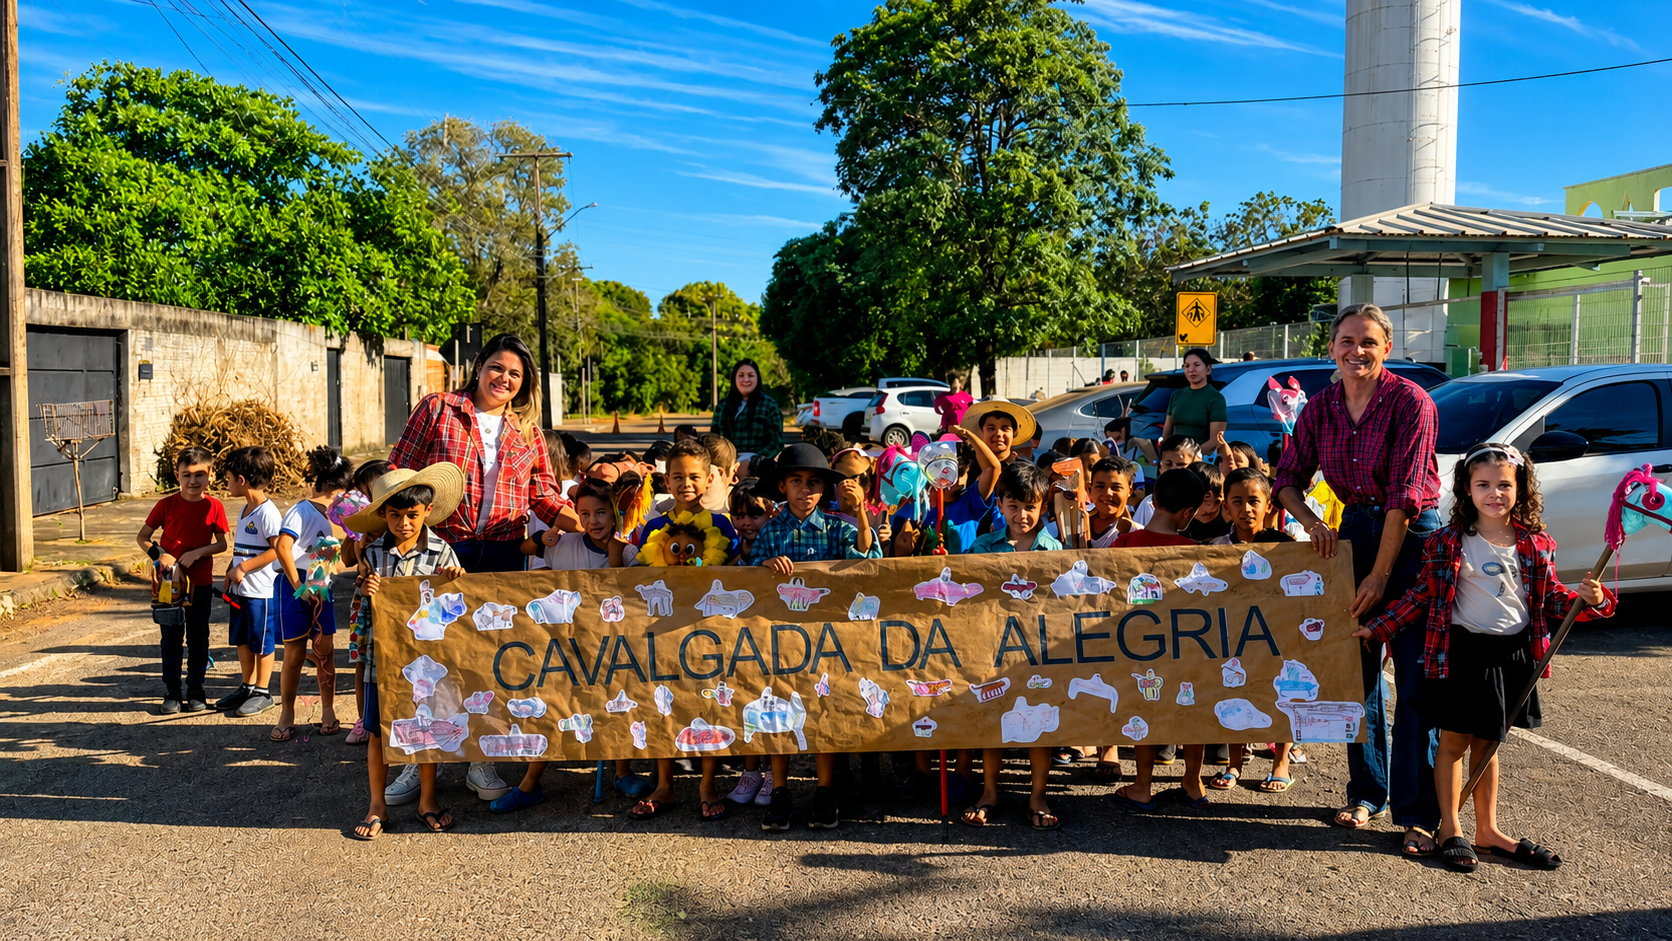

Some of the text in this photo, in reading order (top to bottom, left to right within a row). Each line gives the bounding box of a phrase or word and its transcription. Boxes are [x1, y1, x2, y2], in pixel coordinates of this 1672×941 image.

[493, 605, 1281, 691] CAVALGADA DA ALEGRIA
